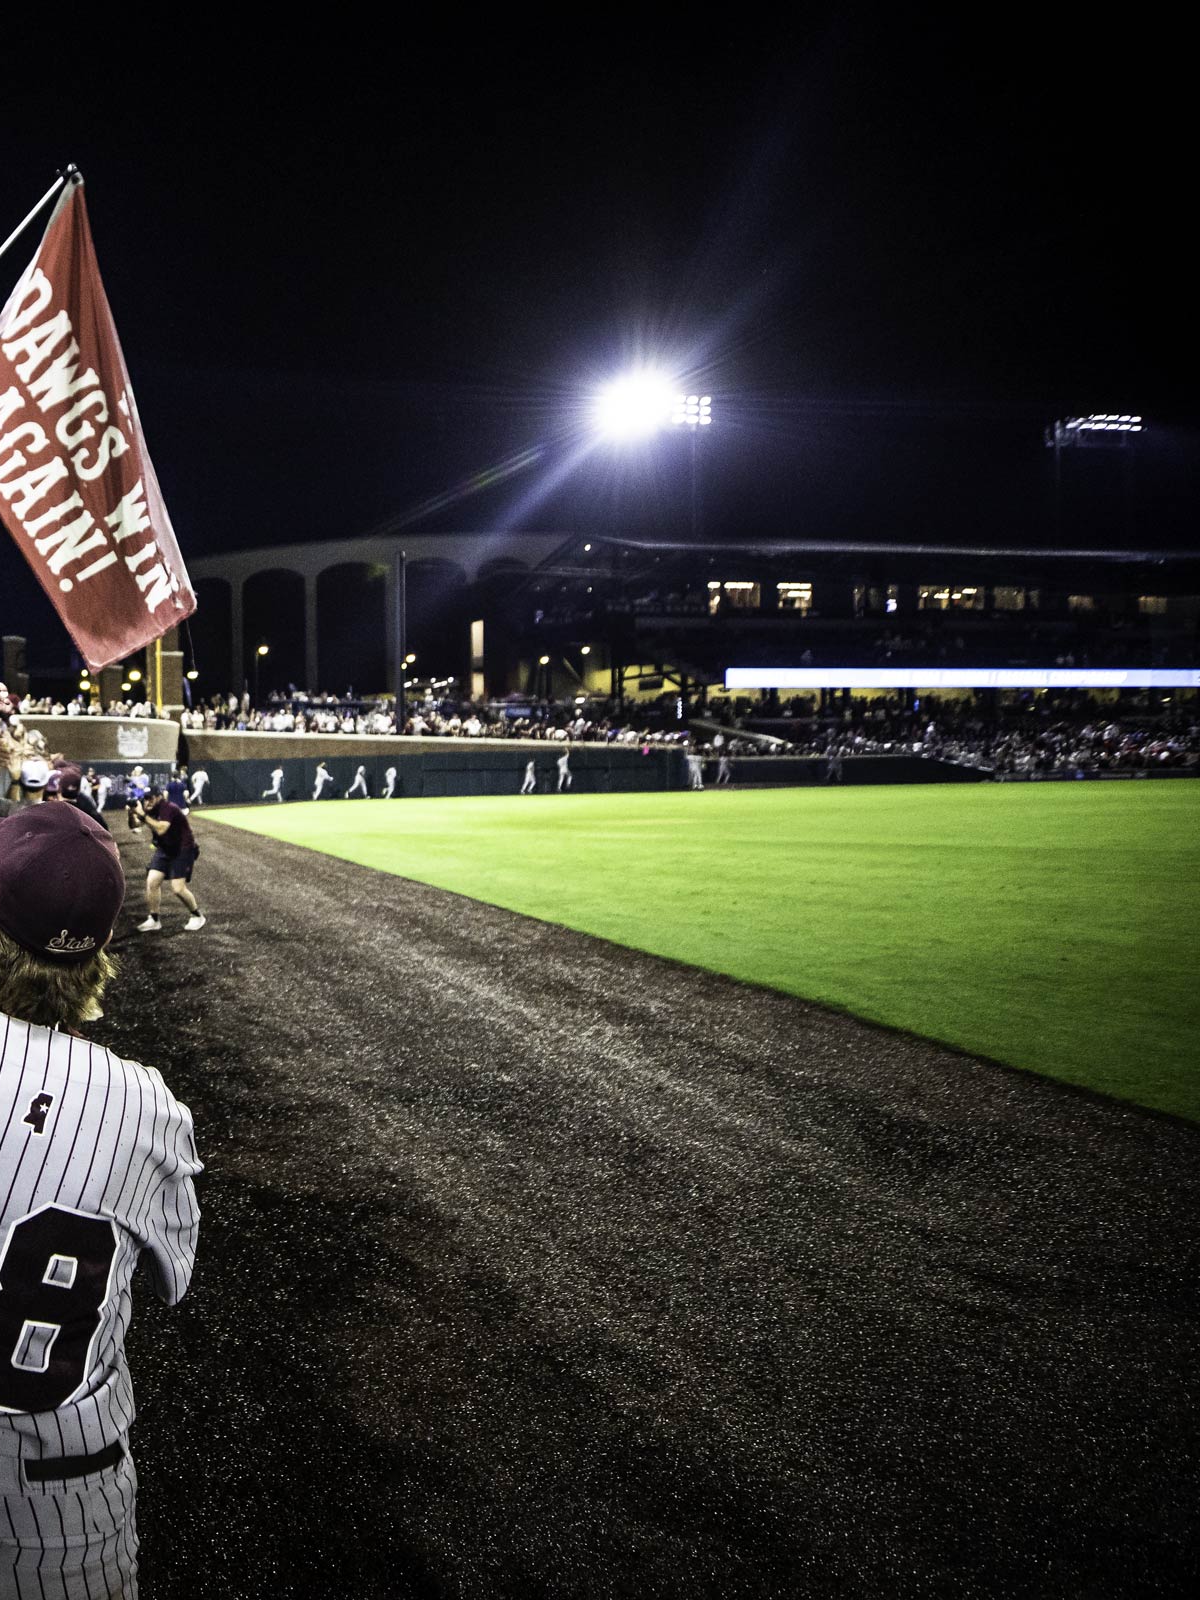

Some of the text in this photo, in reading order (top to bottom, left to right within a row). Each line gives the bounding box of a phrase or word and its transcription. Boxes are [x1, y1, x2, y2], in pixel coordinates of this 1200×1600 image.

[2, 267, 176, 614] DAWGS WIN
[46, 929, 96, 952] State
